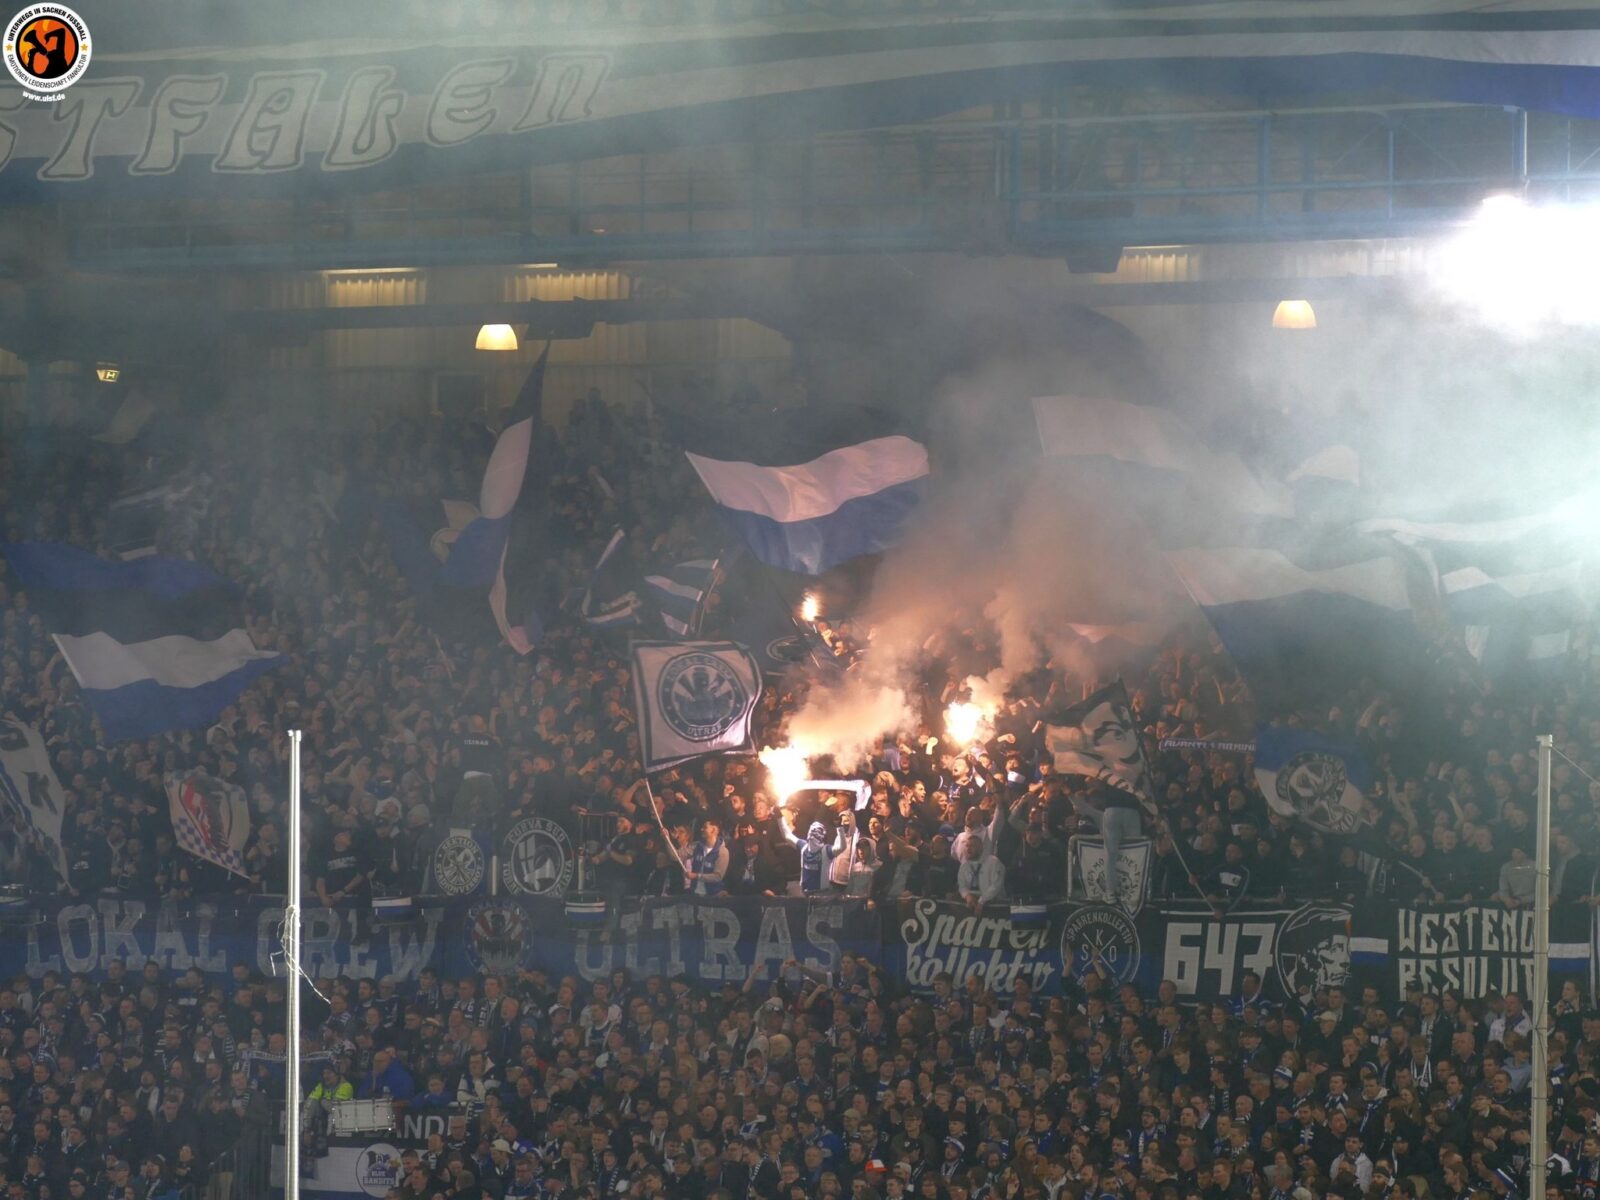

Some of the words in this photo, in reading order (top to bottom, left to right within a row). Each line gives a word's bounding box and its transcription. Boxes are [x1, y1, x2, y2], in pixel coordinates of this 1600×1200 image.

[26, 901, 228, 979] LOKAL
[256, 907, 446, 982] CREW
[575, 904, 845, 982] ULTRAS
[1162, 922, 1276, 996] 647
[1398, 906, 1535, 954] WESTEND
